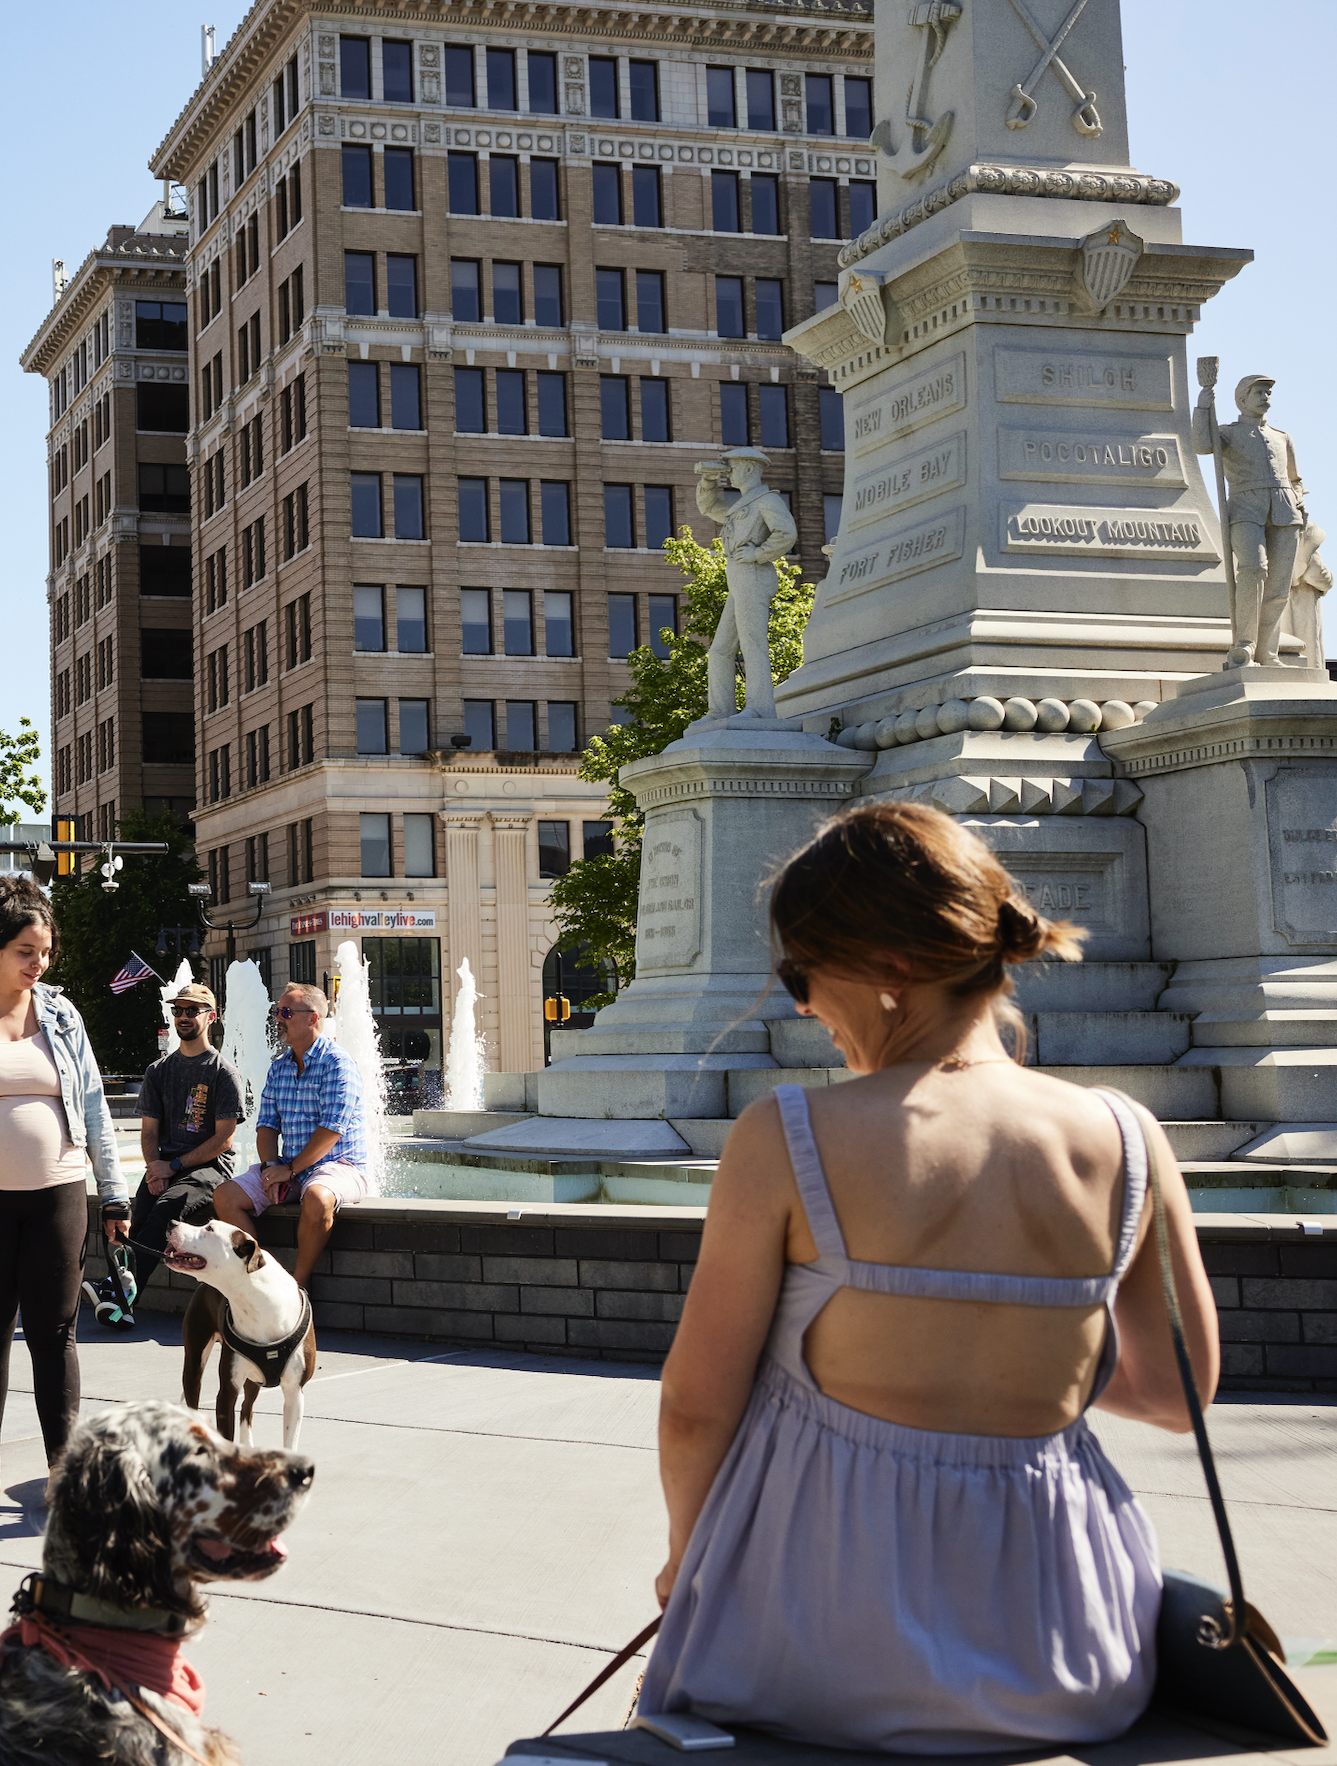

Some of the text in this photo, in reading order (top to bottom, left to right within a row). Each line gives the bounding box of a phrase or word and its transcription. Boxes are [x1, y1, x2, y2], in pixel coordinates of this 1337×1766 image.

[1041, 365, 1136, 392] SHILOH
[854, 373, 954, 439] NEW ORLEANS
[1022, 441, 1169, 469] POCOTALIGO
[854, 451, 953, 512] MOBILE BAY
[1016, 515, 1202, 544] LOOKOUT MOUNTAIN
[839, 526, 947, 585] FORT FISHER
[331, 912, 434, 929] lehighvalleylive.com
